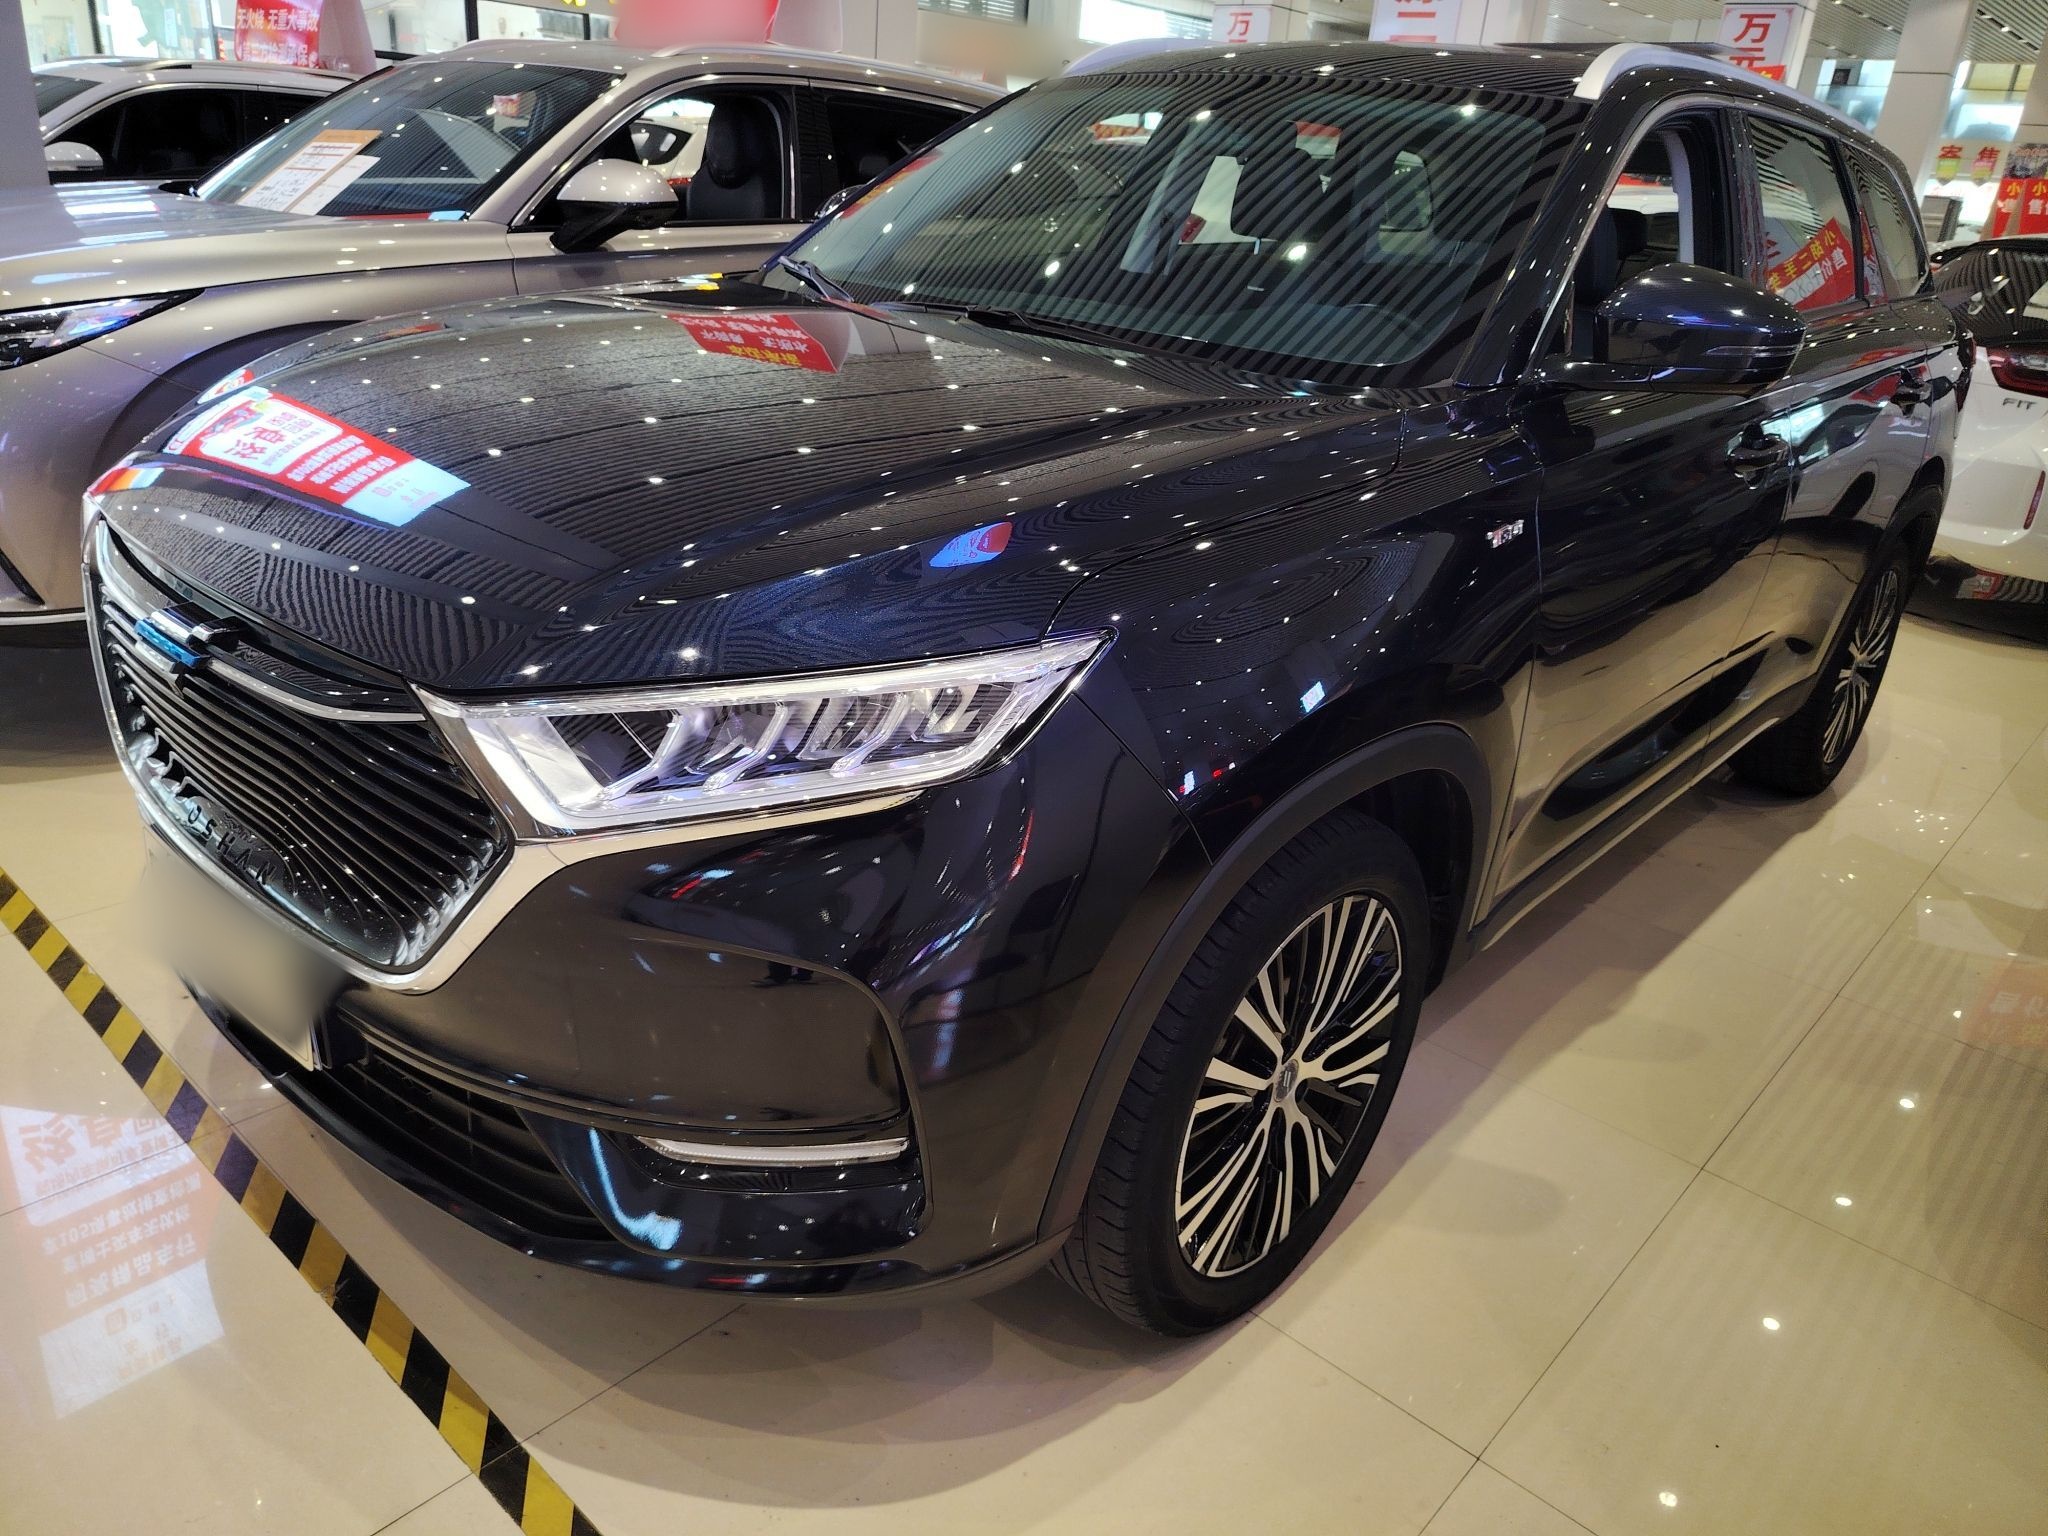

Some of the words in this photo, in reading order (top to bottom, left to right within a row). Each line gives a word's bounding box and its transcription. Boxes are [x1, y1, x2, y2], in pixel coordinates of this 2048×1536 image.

[268, 8, 319, 32] 无重大事故
[1227, 12, 1252, 43] 万
[2002, 397, 2037, 410] FIT
[187, 804, 277, 886] OSHAN
